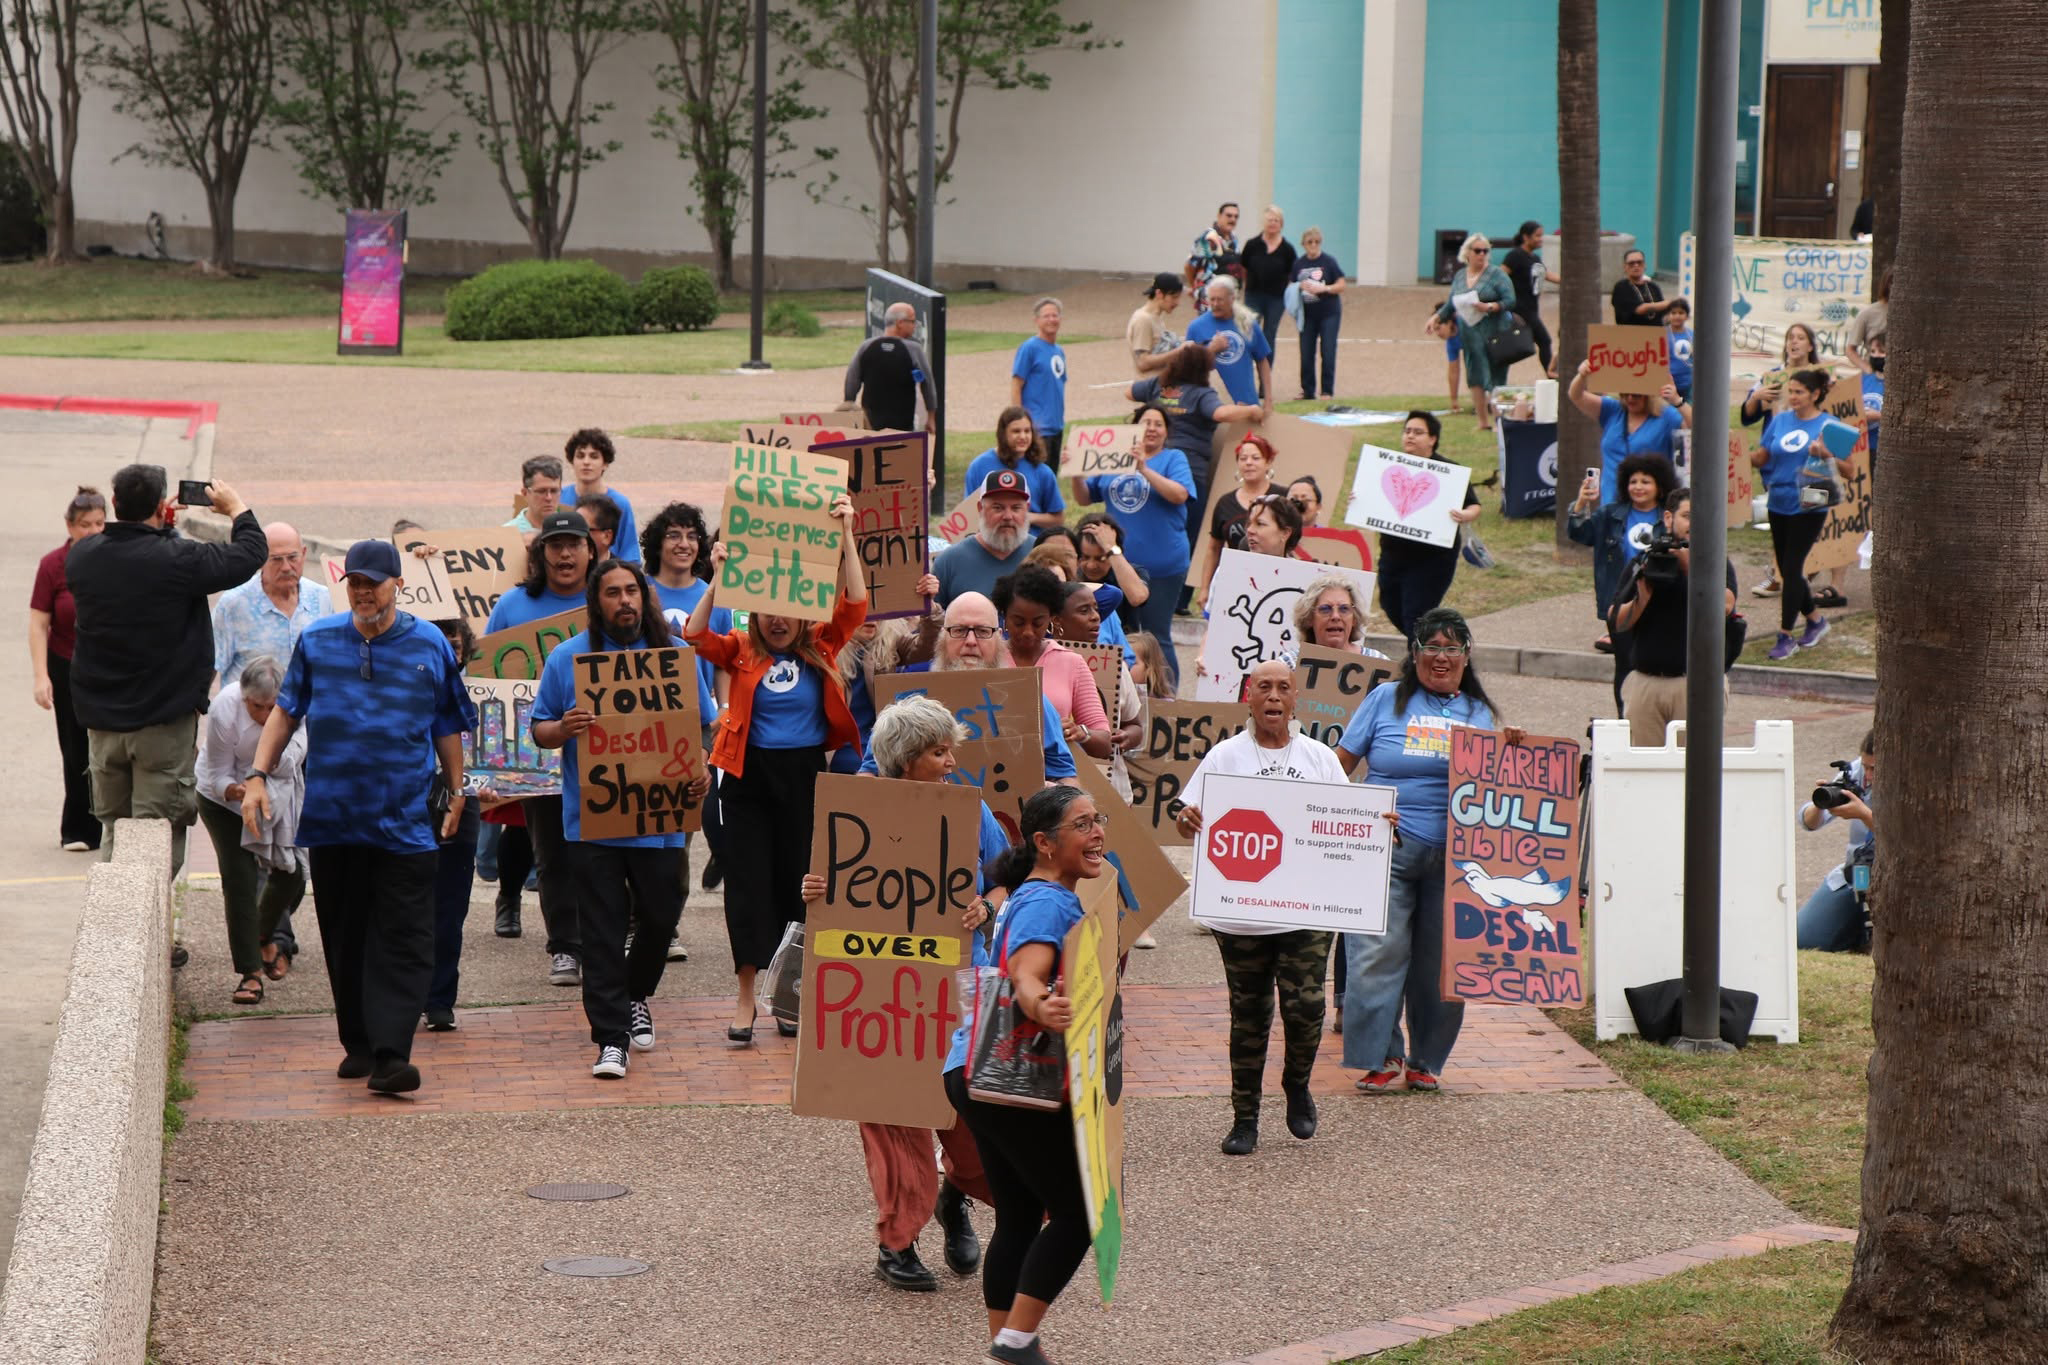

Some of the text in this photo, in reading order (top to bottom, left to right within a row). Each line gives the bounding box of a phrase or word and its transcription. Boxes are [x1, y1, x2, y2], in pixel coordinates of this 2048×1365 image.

[1785, 248, 1868, 271] CORPUS
[1783, 272, 1864, 295] CHRISTI
[1589, 336, 1669, 377] Enough!
[1078, 428, 1116, 448] NO
[1379, 450, 1451, 474] We Stand With
[734, 473, 848, 513] CREST
[728, 505, 841, 549] Deserves
[939, 511, 968, 542] NO
[1366, 517, 1432, 539] HILLCREST
[721, 540, 836, 608] Better
[576, 649, 680, 684] TAKE
[584, 681, 684, 715] YOUR
[588, 720, 697, 778] Desal &
[1453, 730, 1496, 783] WE
[1496, 741, 1580, 799] ARENT
[587, 763, 698, 814] Shove
[636, 808, 685, 836] IT!
[1306, 804, 1380, 819] Stop sacrificing
[1451, 782, 1571, 838] GULL
[1312, 820, 1373, 838] HILLCREST
[1212, 830, 1279, 861] STOP
[1295, 838, 1385, 854] to support industry
[1323, 852, 1355, 861] needs.
[826, 811, 973, 932] People
[1221, 895, 1363, 916] No DESALINATION in Hillcrest
[1454, 902, 1578, 955] DESAL
[843, 933, 943, 959] OVER
[1477, 952, 1547, 972] IS A
[1454, 962, 1582, 1004] SCAM
[815, 961, 958, 1062] Profit
